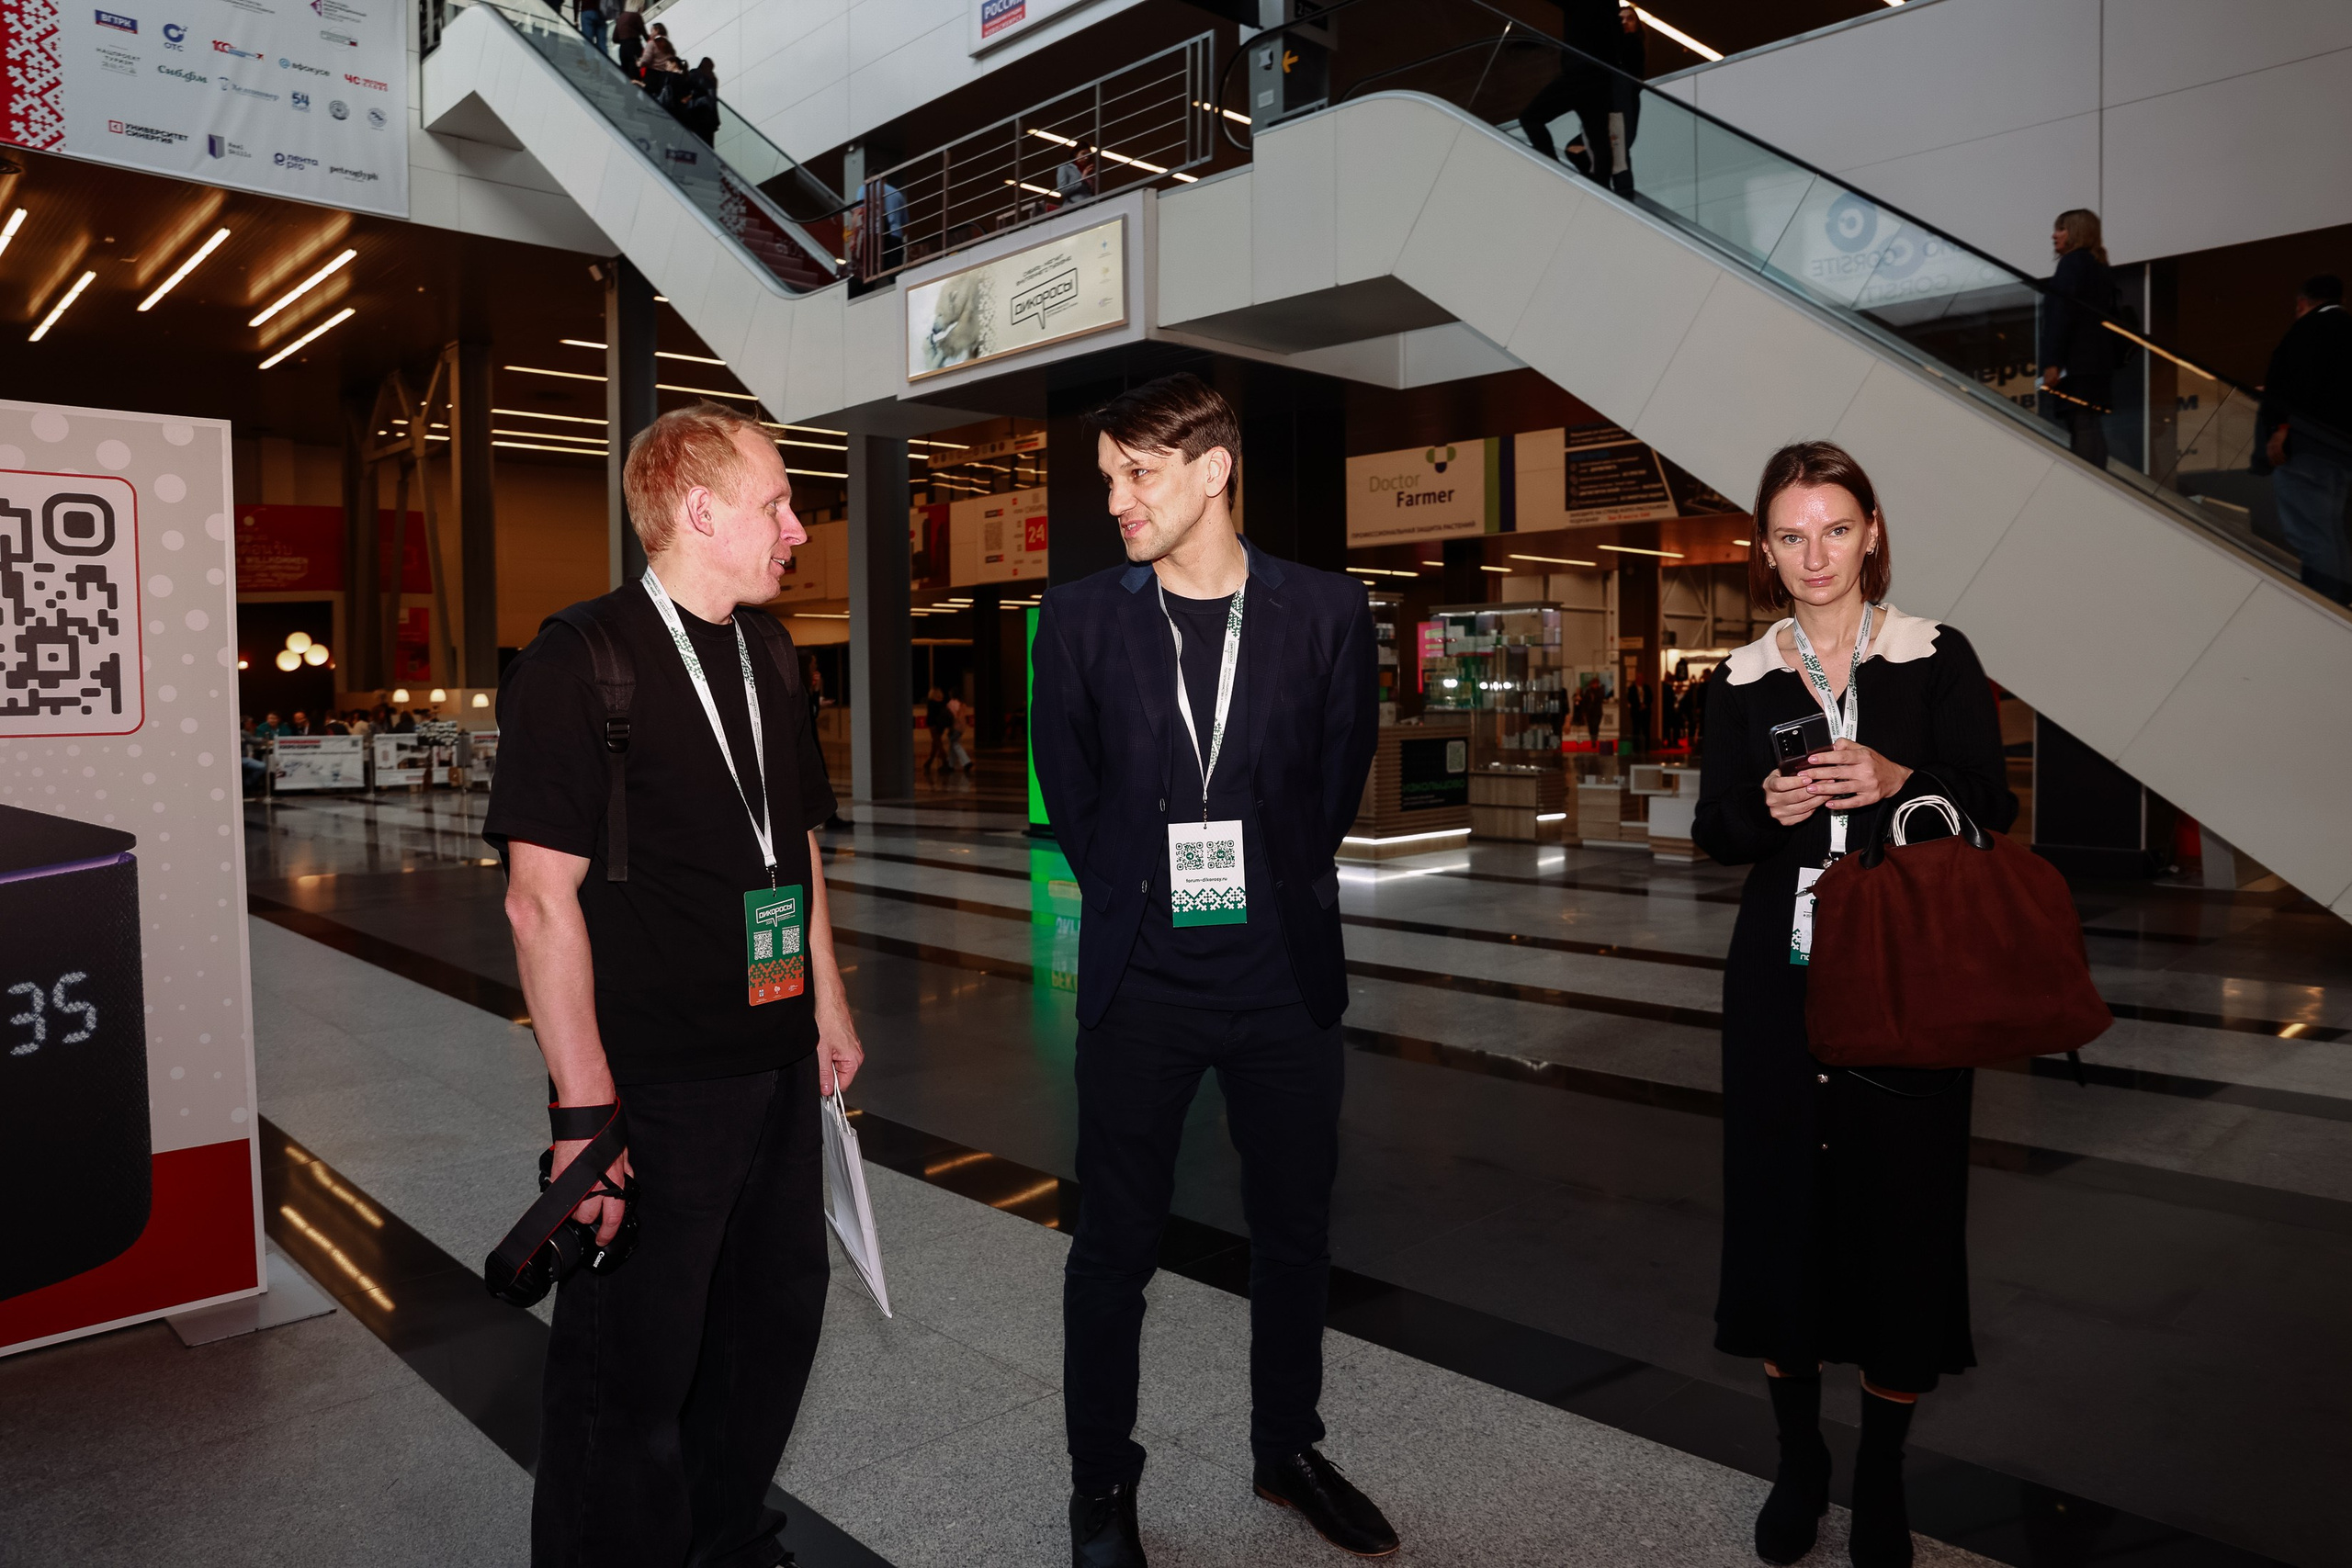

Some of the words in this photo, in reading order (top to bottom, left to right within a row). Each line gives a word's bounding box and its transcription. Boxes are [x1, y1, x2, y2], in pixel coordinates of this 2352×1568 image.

[985, 0, 1023, 19] РОСС
[100, 13, 133, 28] ВГТРК
[164, 41, 184, 52] ОТС
[157, 64, 208, 84] Сиб.фм
[292, 92, 310, 107] 54
[125, 122, 189, 141] УНИВЕРСИТЕТ
[125, 130, 174, 145] СИНЕРГИЯ
[287, 153, 319, 166] лента
[1014, 278, 1074, 316] ДИКОРОСЫ
[1368, 472, 1421, 493] Doctor
[1396, 488, 1455, 509] Farmer
[1027, 524, 1046, 544] 24
[758, 903, 793, 919] ДИКОРОСЫ
[7, 972, 96, 1055] 35
[592, 1250, 605, 1269] Canon
